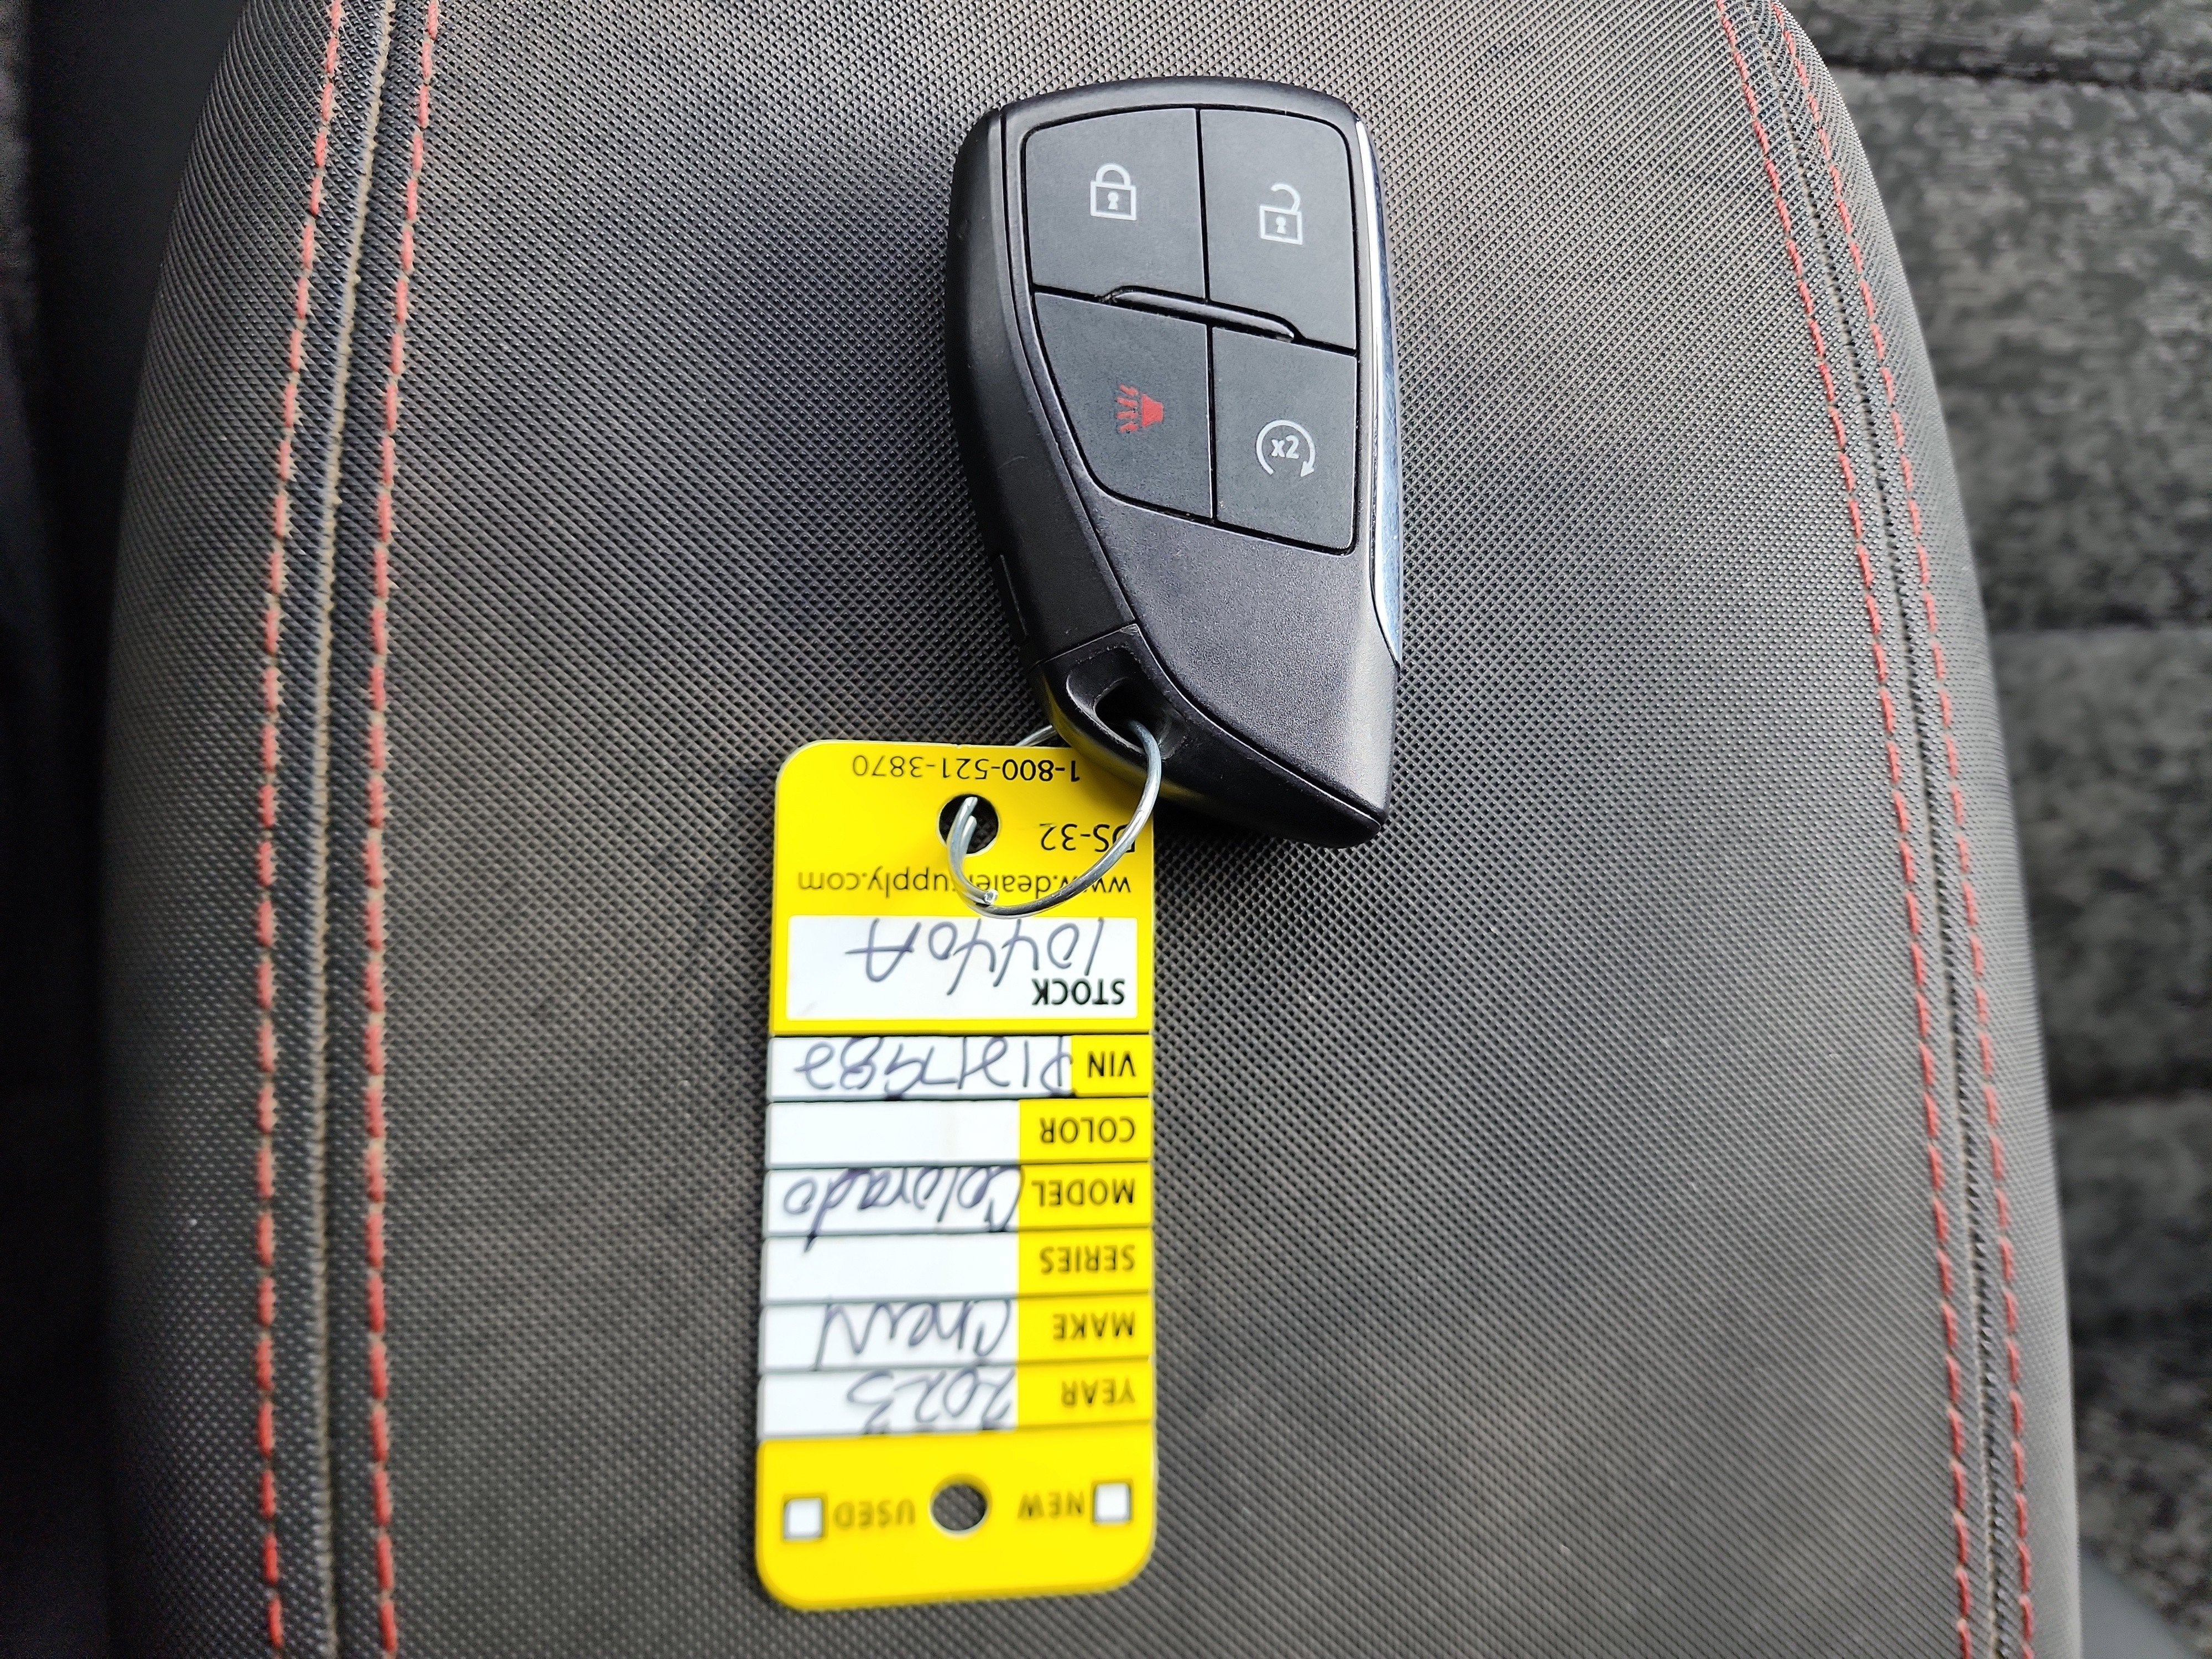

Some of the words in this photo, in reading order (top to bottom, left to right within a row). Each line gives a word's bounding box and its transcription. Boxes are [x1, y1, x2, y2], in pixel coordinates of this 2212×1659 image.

[1271, 435, 1299, 459] x2
[852, 754, 1080, 782] 1-800-521-3870
[798, 867, 1131, 898] ww.dealeupply.com
[846, 918, 1103, 995] 10440A
[1032, 979, 1125, 1005] STOCK
[1089, 1051, 1136, 1077] VIN
[1040, 1117, 1135, 1144] COLOR
[1031, 1179, 1135, 1206] MODEL
[784, 1167, 1024, 1253] Colorado
[1040, 1245, 1135, 1274] SERIES
[1053, 1312, 1135, 1340] MAKE
[847, 1367, 1015, 1434] 2023
[1061, 1379, 1136, 1407] YEAR
[833, 1499, 915, 1528] USED
[1018, 1491, 1084, 1519] NEW
